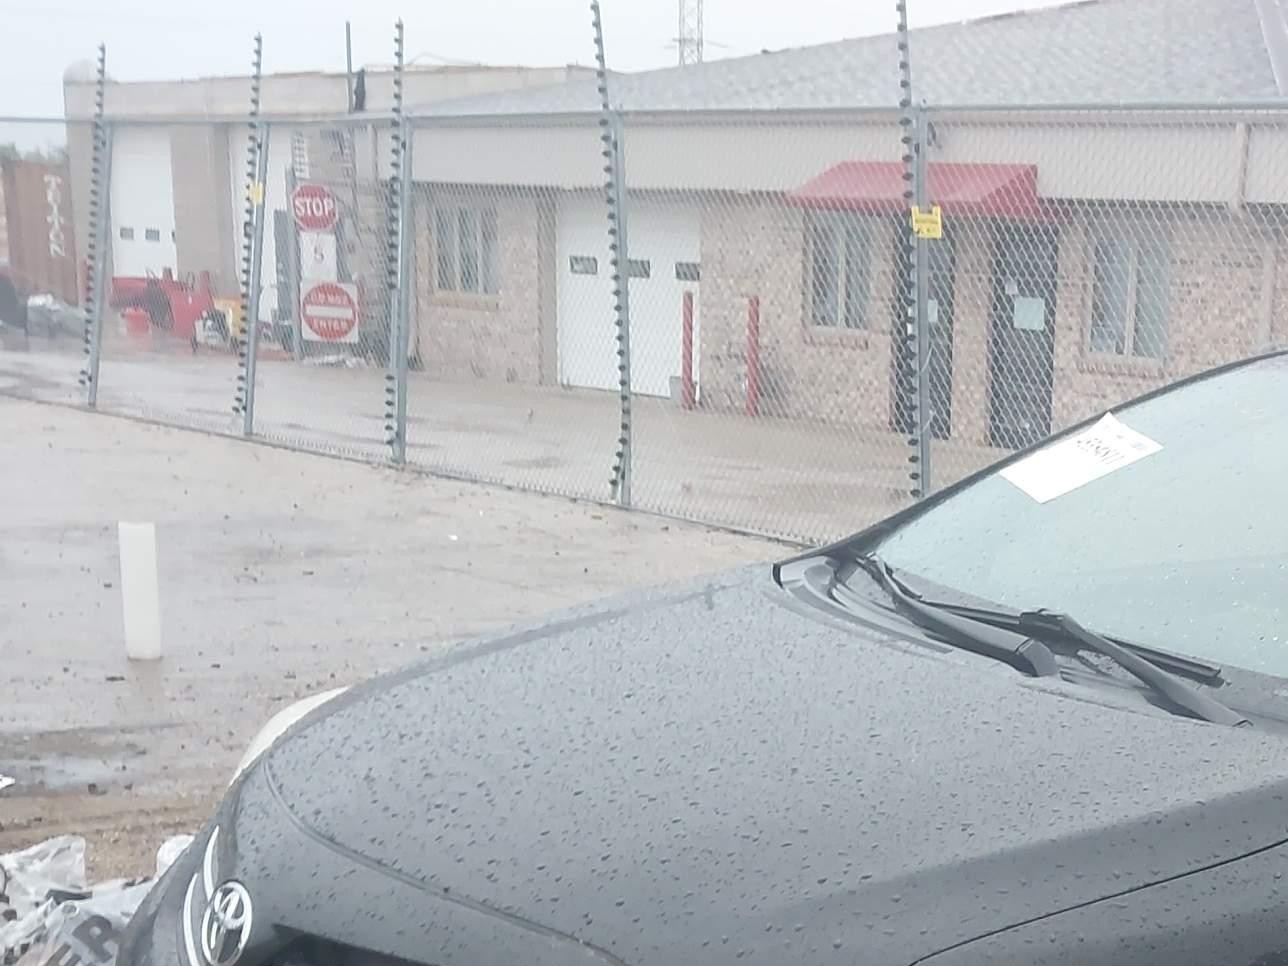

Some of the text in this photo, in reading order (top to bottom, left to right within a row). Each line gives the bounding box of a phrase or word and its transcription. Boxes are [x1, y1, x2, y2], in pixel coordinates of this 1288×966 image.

[294, 197, 333, 216] STOP
[310, 292, 348, 305] DO NOT
[313, 318, 349, 331] ENTER
